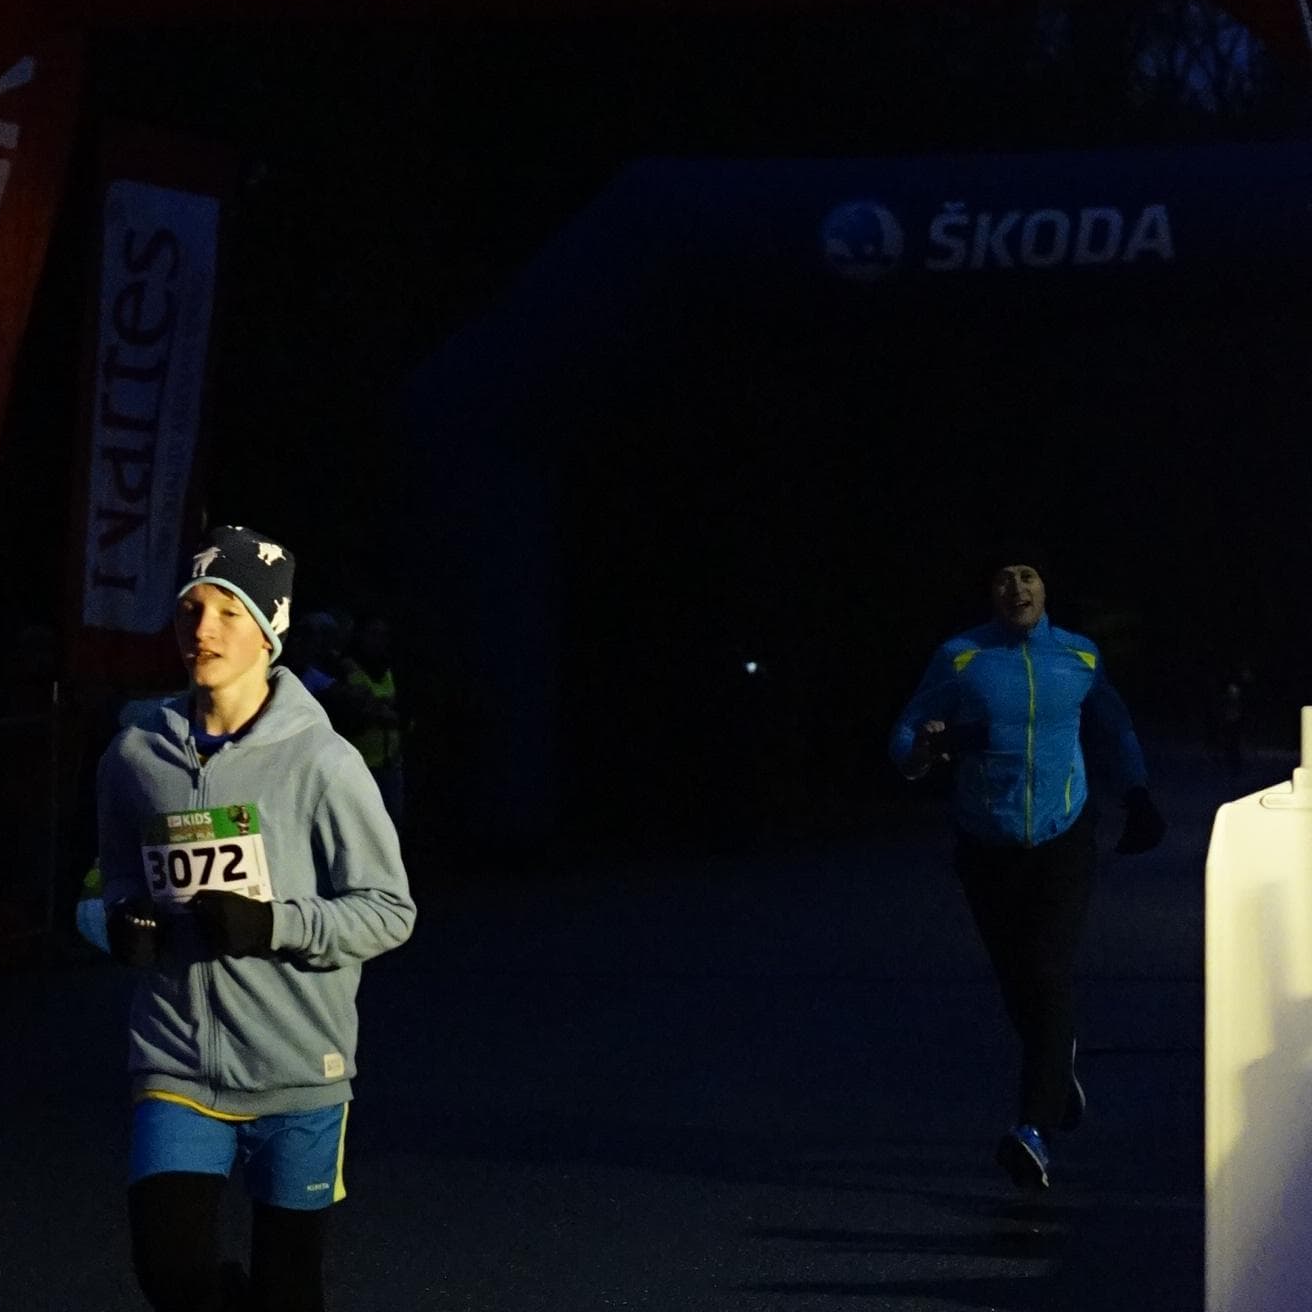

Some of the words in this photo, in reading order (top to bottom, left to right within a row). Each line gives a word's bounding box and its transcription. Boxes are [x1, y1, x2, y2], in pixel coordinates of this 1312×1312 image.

[924, 200, 1176, 271] ŠKODA
[182, 812, 212, 826] KIDS
[148, 844, 247, 890] 3072
